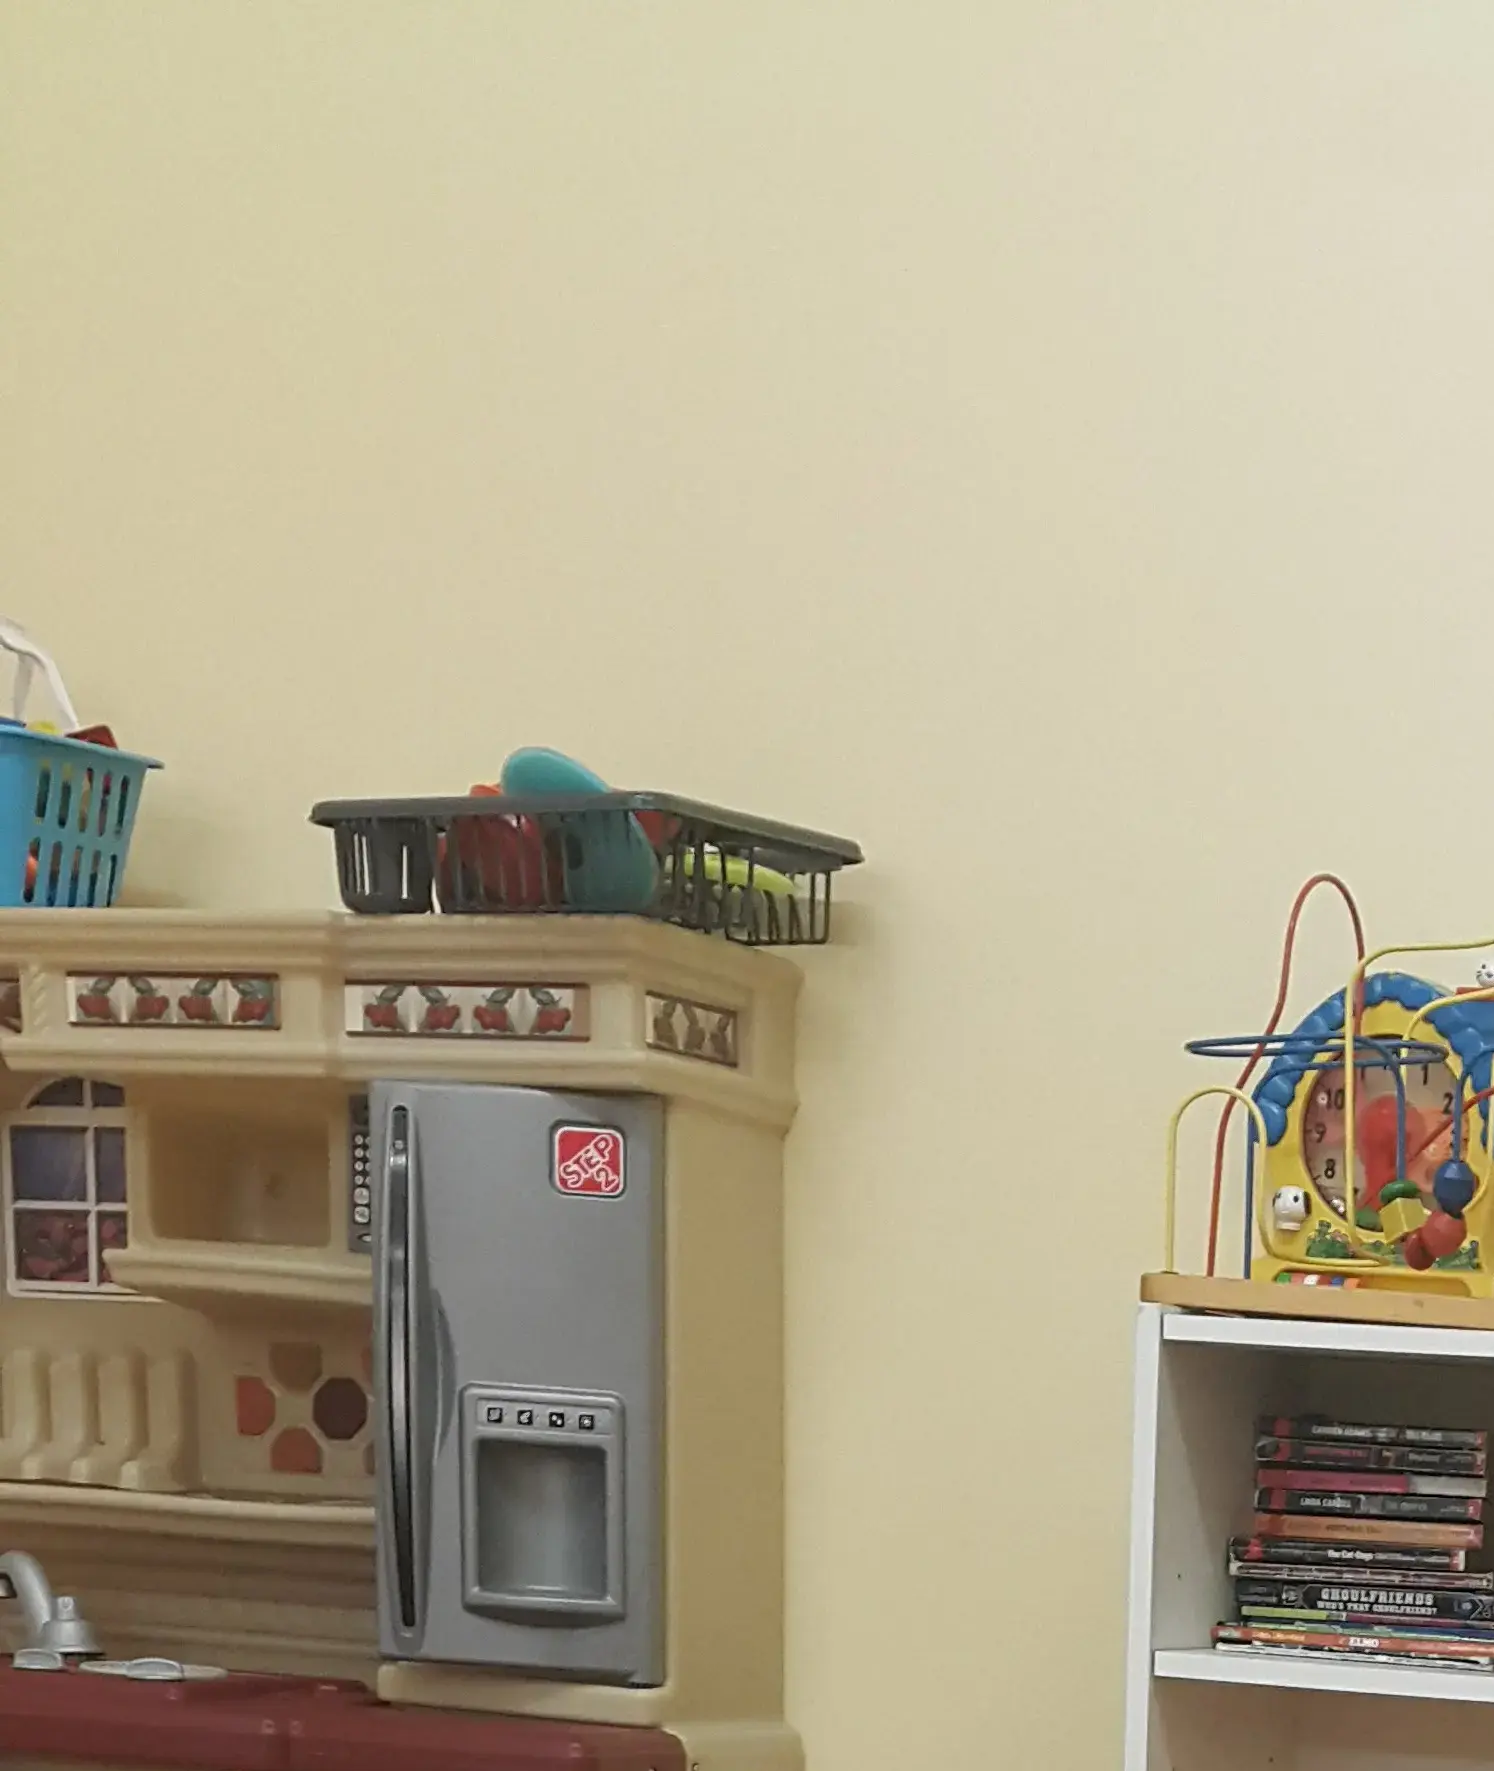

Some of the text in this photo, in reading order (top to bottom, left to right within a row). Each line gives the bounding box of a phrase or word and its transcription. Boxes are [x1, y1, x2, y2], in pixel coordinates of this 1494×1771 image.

[560, 1134, 614, 1188] STEP
[1324, 1158, 1336, 1179] 8
[594, 1164, 619, 1191] 2
[1321, 1588, 1435, 1606] GHOULFRIENDS
[1316, 1600, 1438, 1615] WHO'S THAT GHOULFRIEND?
[1349, 1637, 1380, 1648] ELMO
